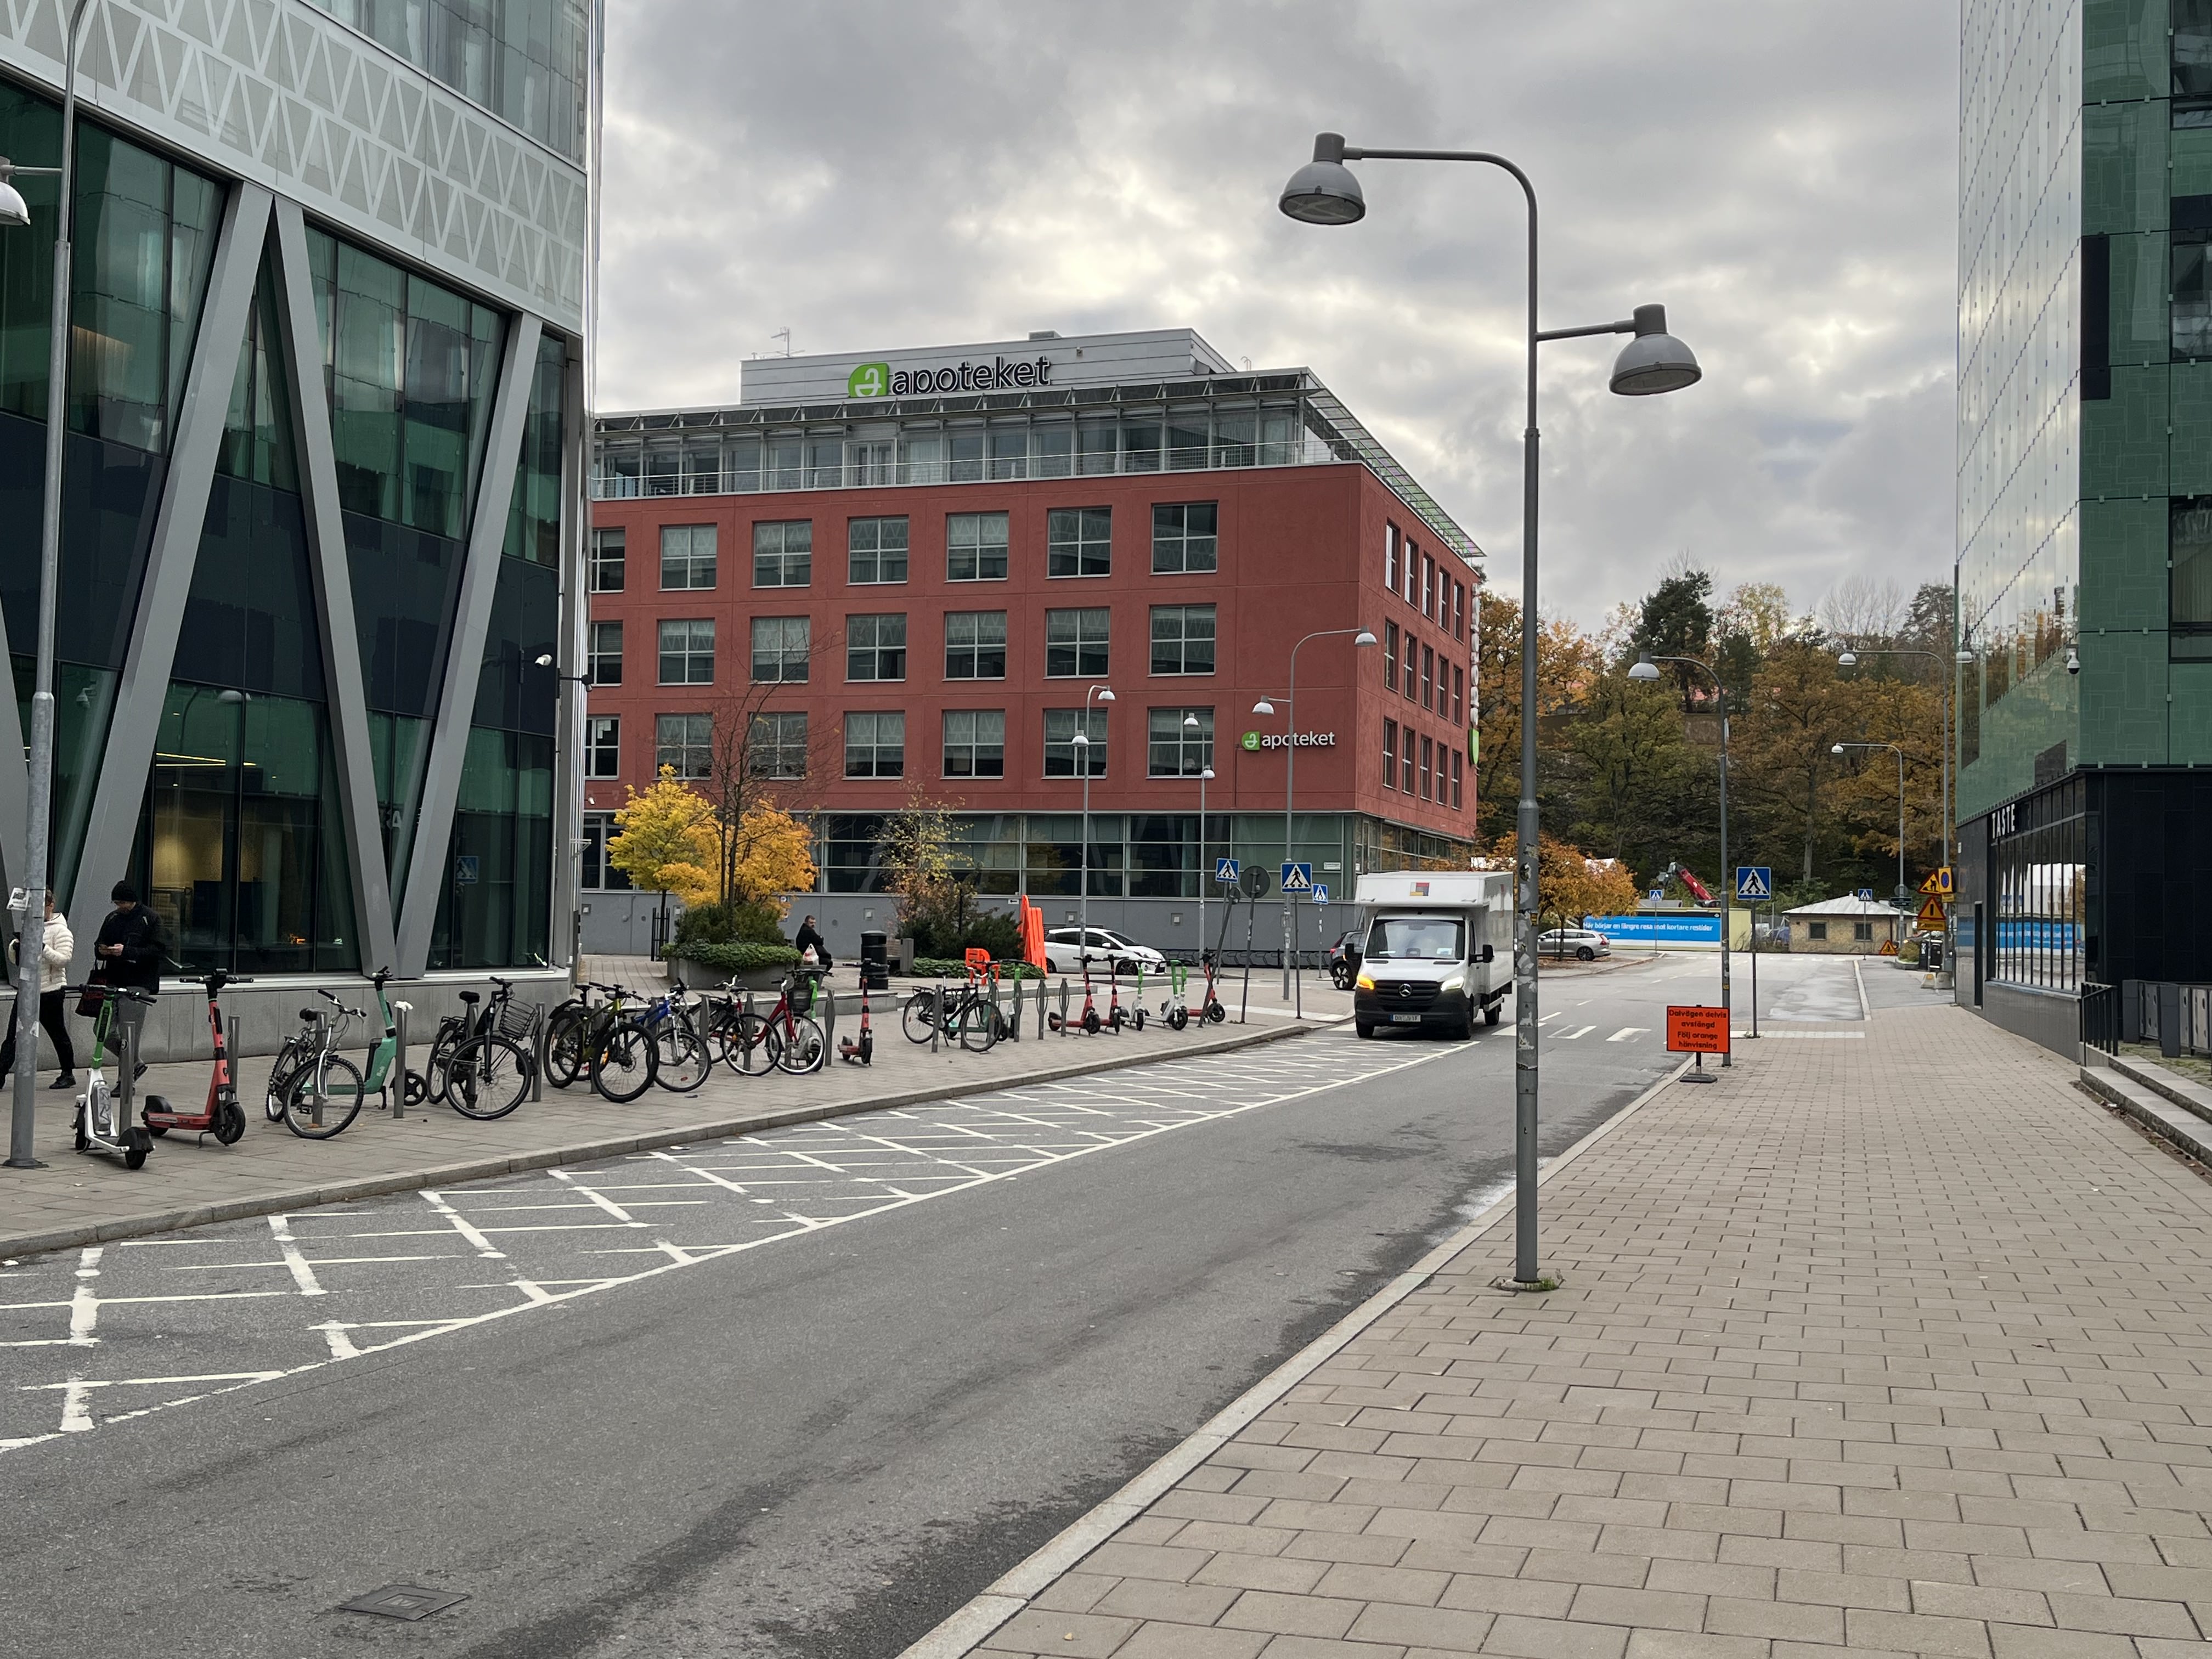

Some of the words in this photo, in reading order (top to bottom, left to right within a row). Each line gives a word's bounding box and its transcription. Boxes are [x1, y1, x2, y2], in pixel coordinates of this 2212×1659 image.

[890, 355, 1052, 395] apoteket
[1262, 731, 1335, 749] apoteket
[1991, 804, 2015, 839] TASTE
[1681, 1021, 1715, 1029] avstängd
[1679, 1041, 1717, 1049] hänvisning
